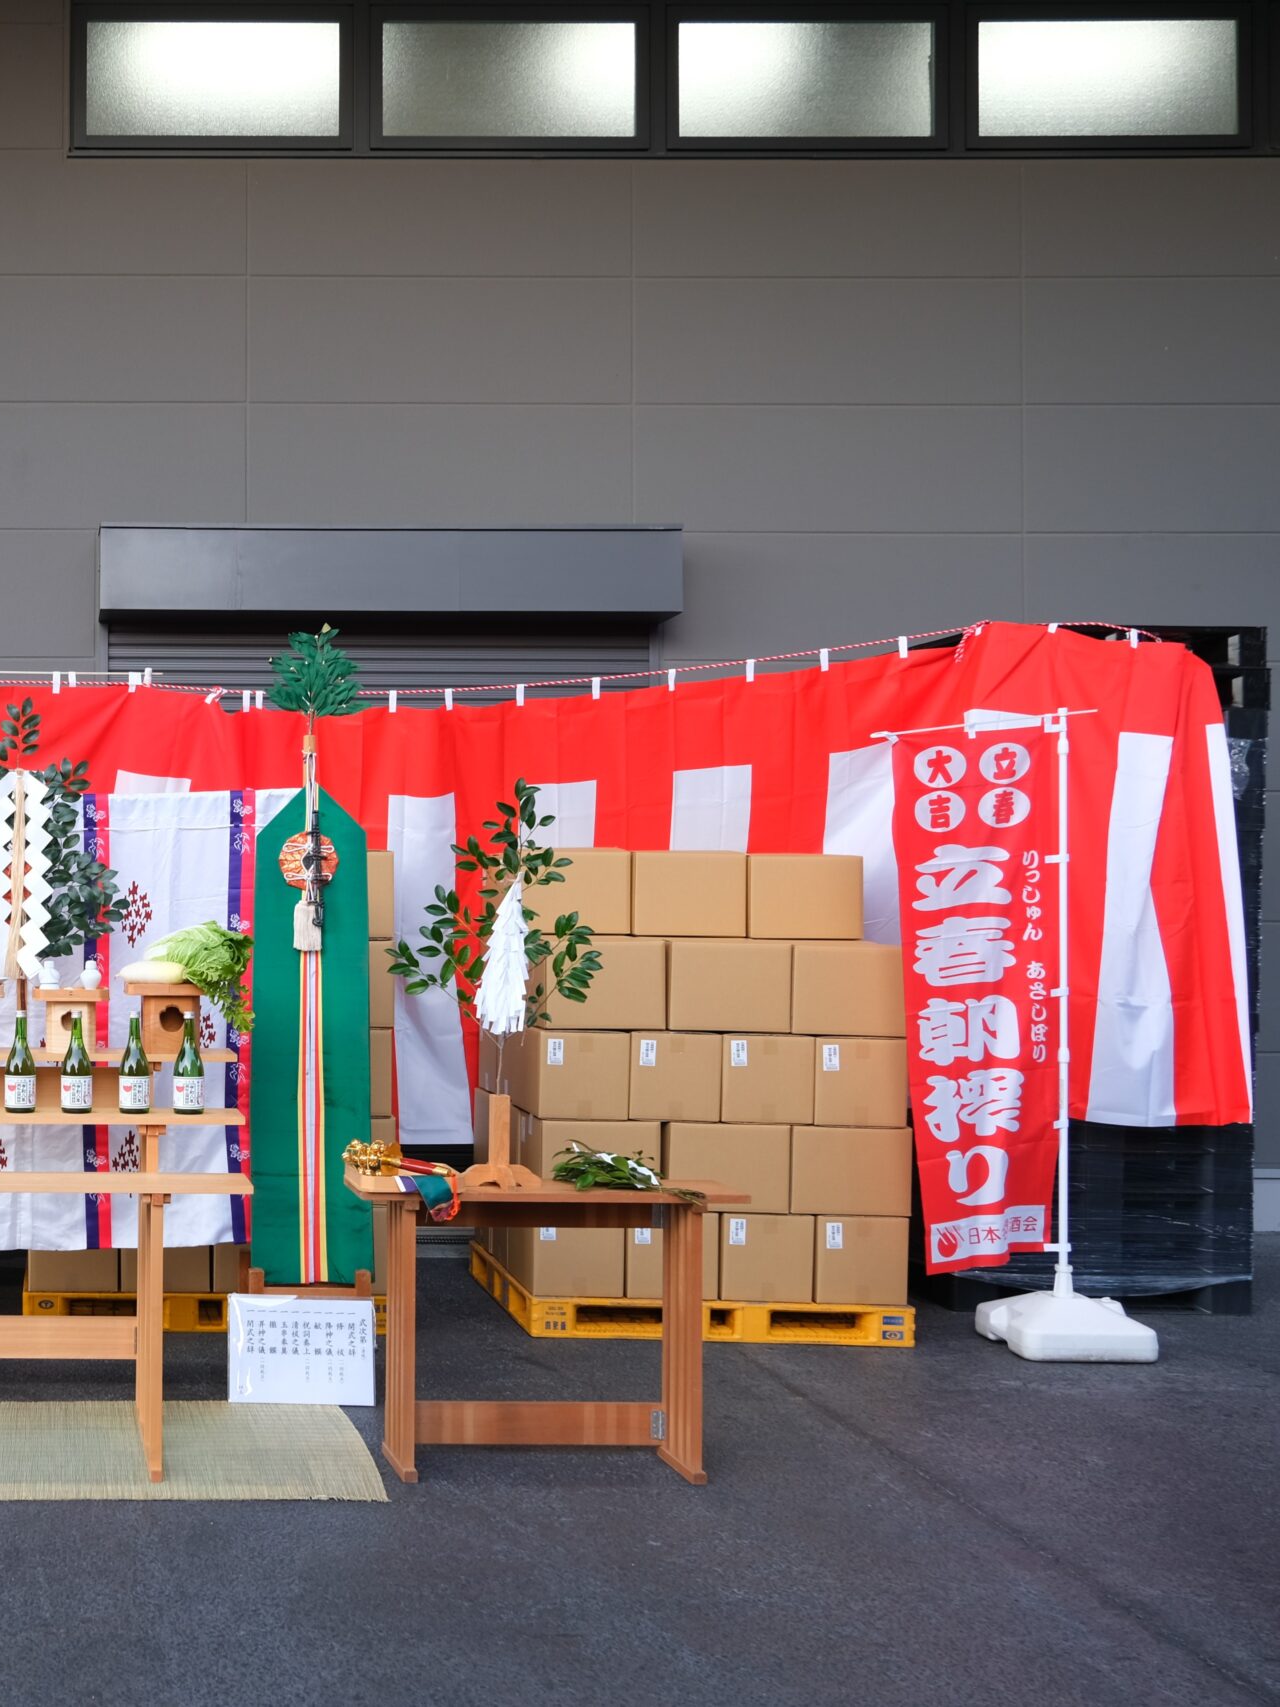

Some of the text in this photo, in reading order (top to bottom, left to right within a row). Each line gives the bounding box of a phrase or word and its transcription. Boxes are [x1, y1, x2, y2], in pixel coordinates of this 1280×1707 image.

[912, 844, 1025, 1206] 立春朝搾り
[1022, 850, 1049, 1063] りっしゅん あさしぼり
[968, 1216, 1038, 1245] 日本酒会
